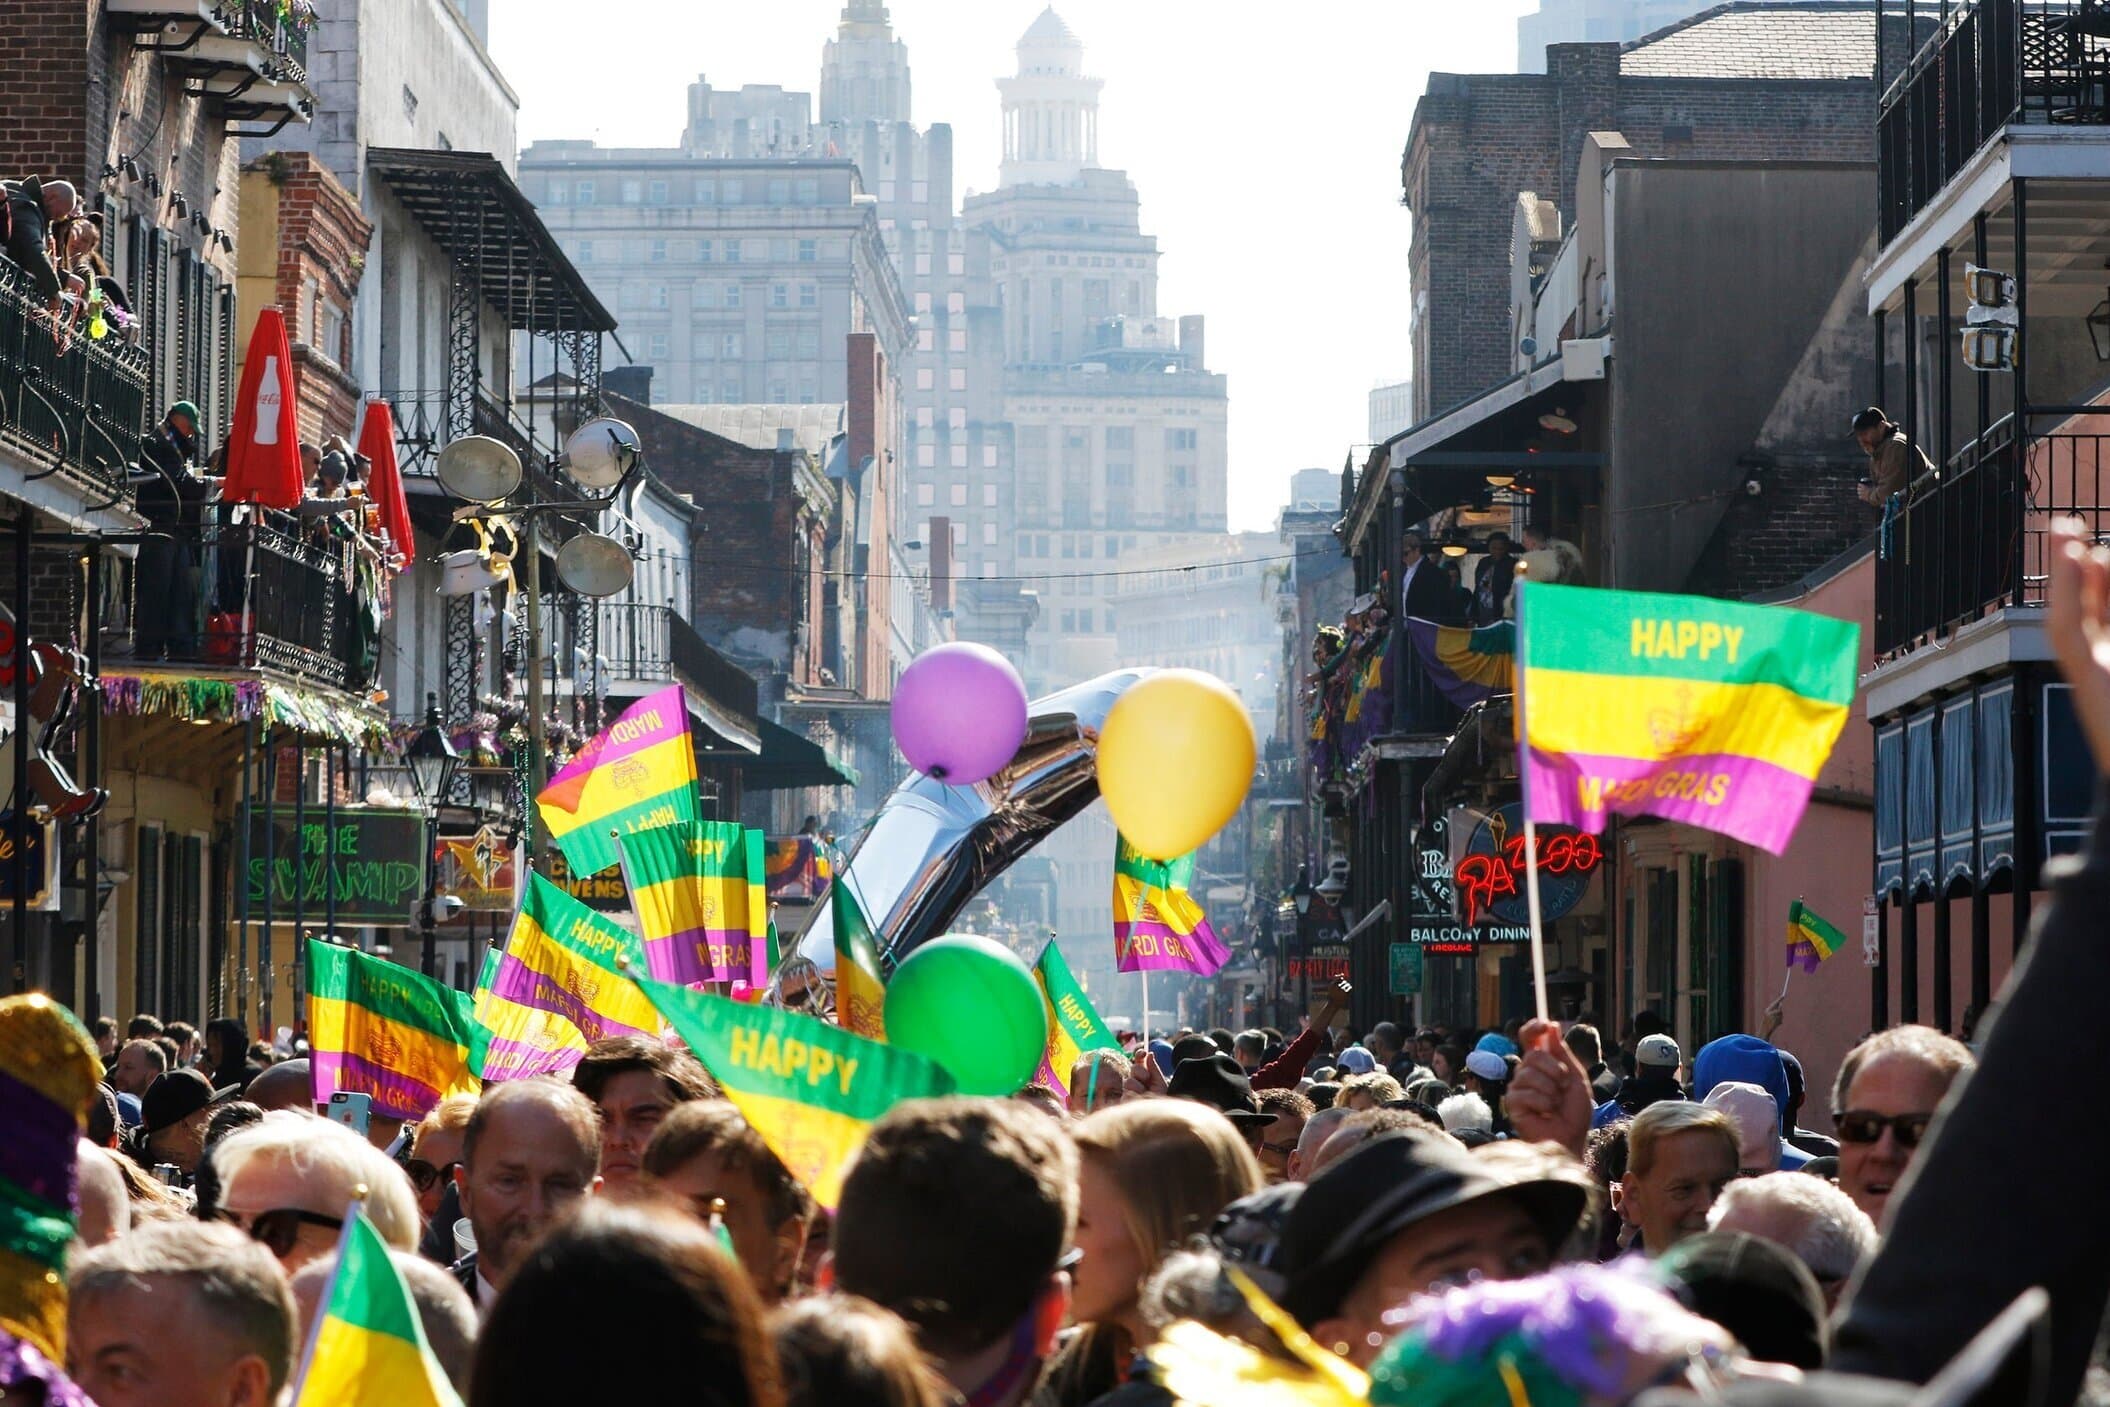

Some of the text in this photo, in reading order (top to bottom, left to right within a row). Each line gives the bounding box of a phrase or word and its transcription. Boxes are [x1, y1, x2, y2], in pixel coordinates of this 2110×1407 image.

[1631, 618, 1744, 664] HAPPY
[610, 710, 664, 745] MARDI
[1654, 771, 1731, 806] GRAS
[293, 823, 359, 854] THE
[248, 858, 420, 904] SWAMP
[552, 880, 625, 898] WENS
[571, 917, 626, 961] HAPPY
[1411, 928, 1532, 941] BALCONY DININ
[1289, 960, 1322, 978] BAELY
[361, 975, 412, 1008] HAPPY
[535, 984, 612, 1041] MARDI GRA
[1058, 993, 1097, 1040] HAPPY
[729, 1024, 859, 1096] HAPPY
